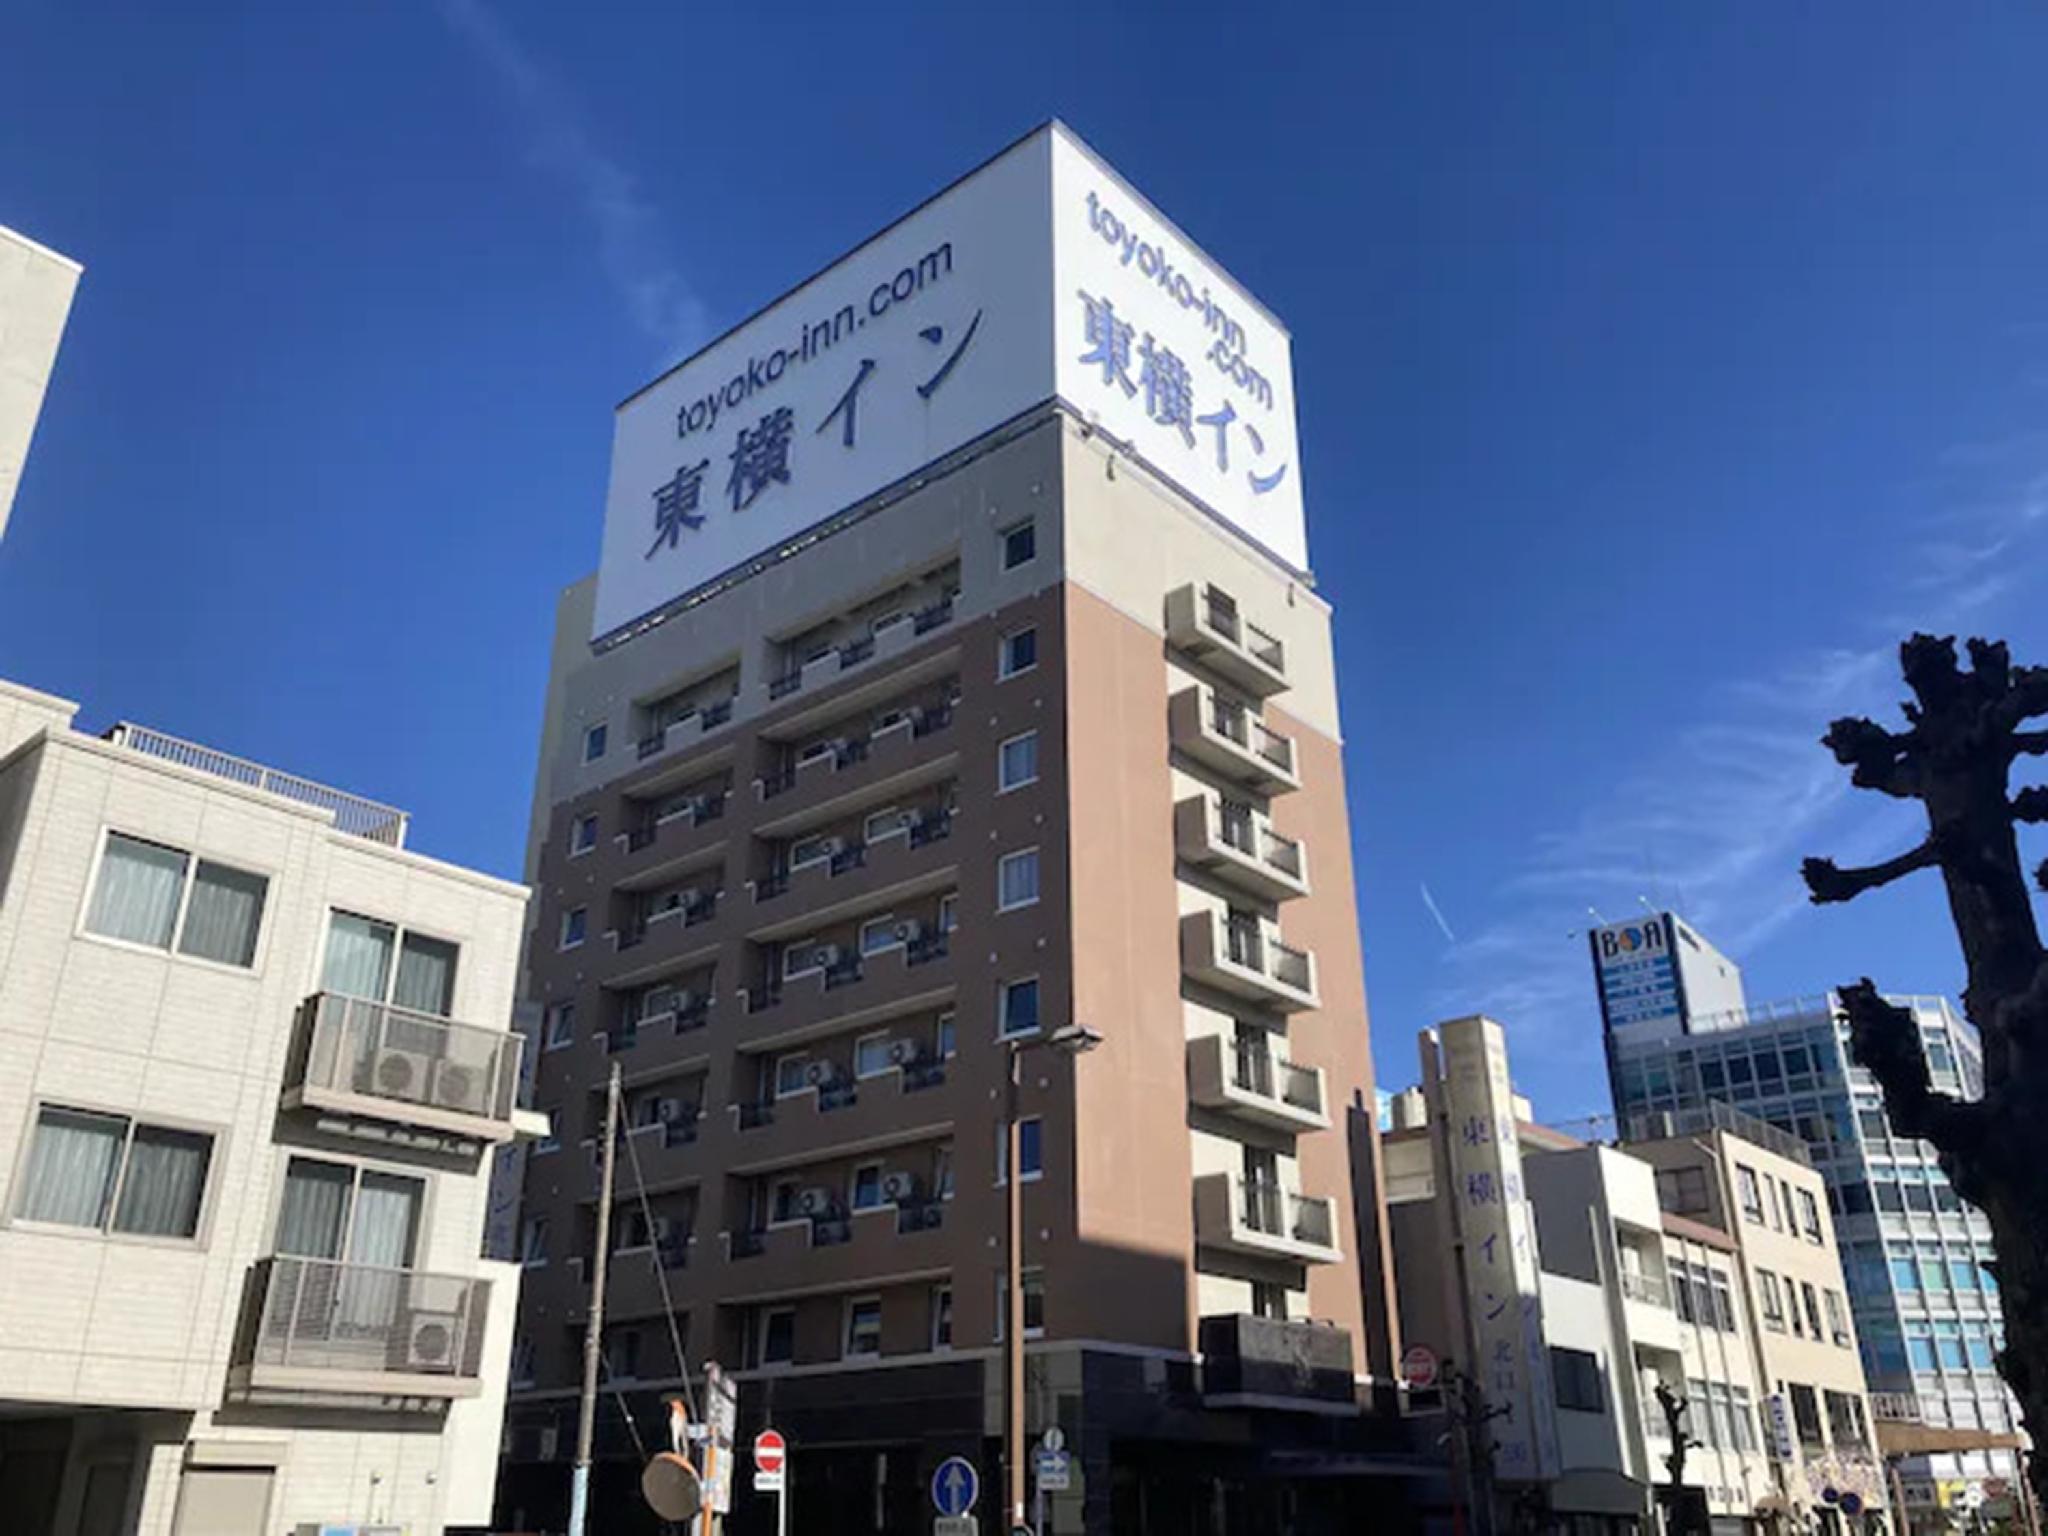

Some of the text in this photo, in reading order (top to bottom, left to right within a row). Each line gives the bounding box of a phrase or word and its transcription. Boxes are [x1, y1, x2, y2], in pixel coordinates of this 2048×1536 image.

[677, 242, 952, 440] toyoko-inn.com
[1087, 189, 1248, 356] toyoko-inn
[645, 309, 982, 560] 東横イン
[1077, 289, 1287, 493] 東横イン
